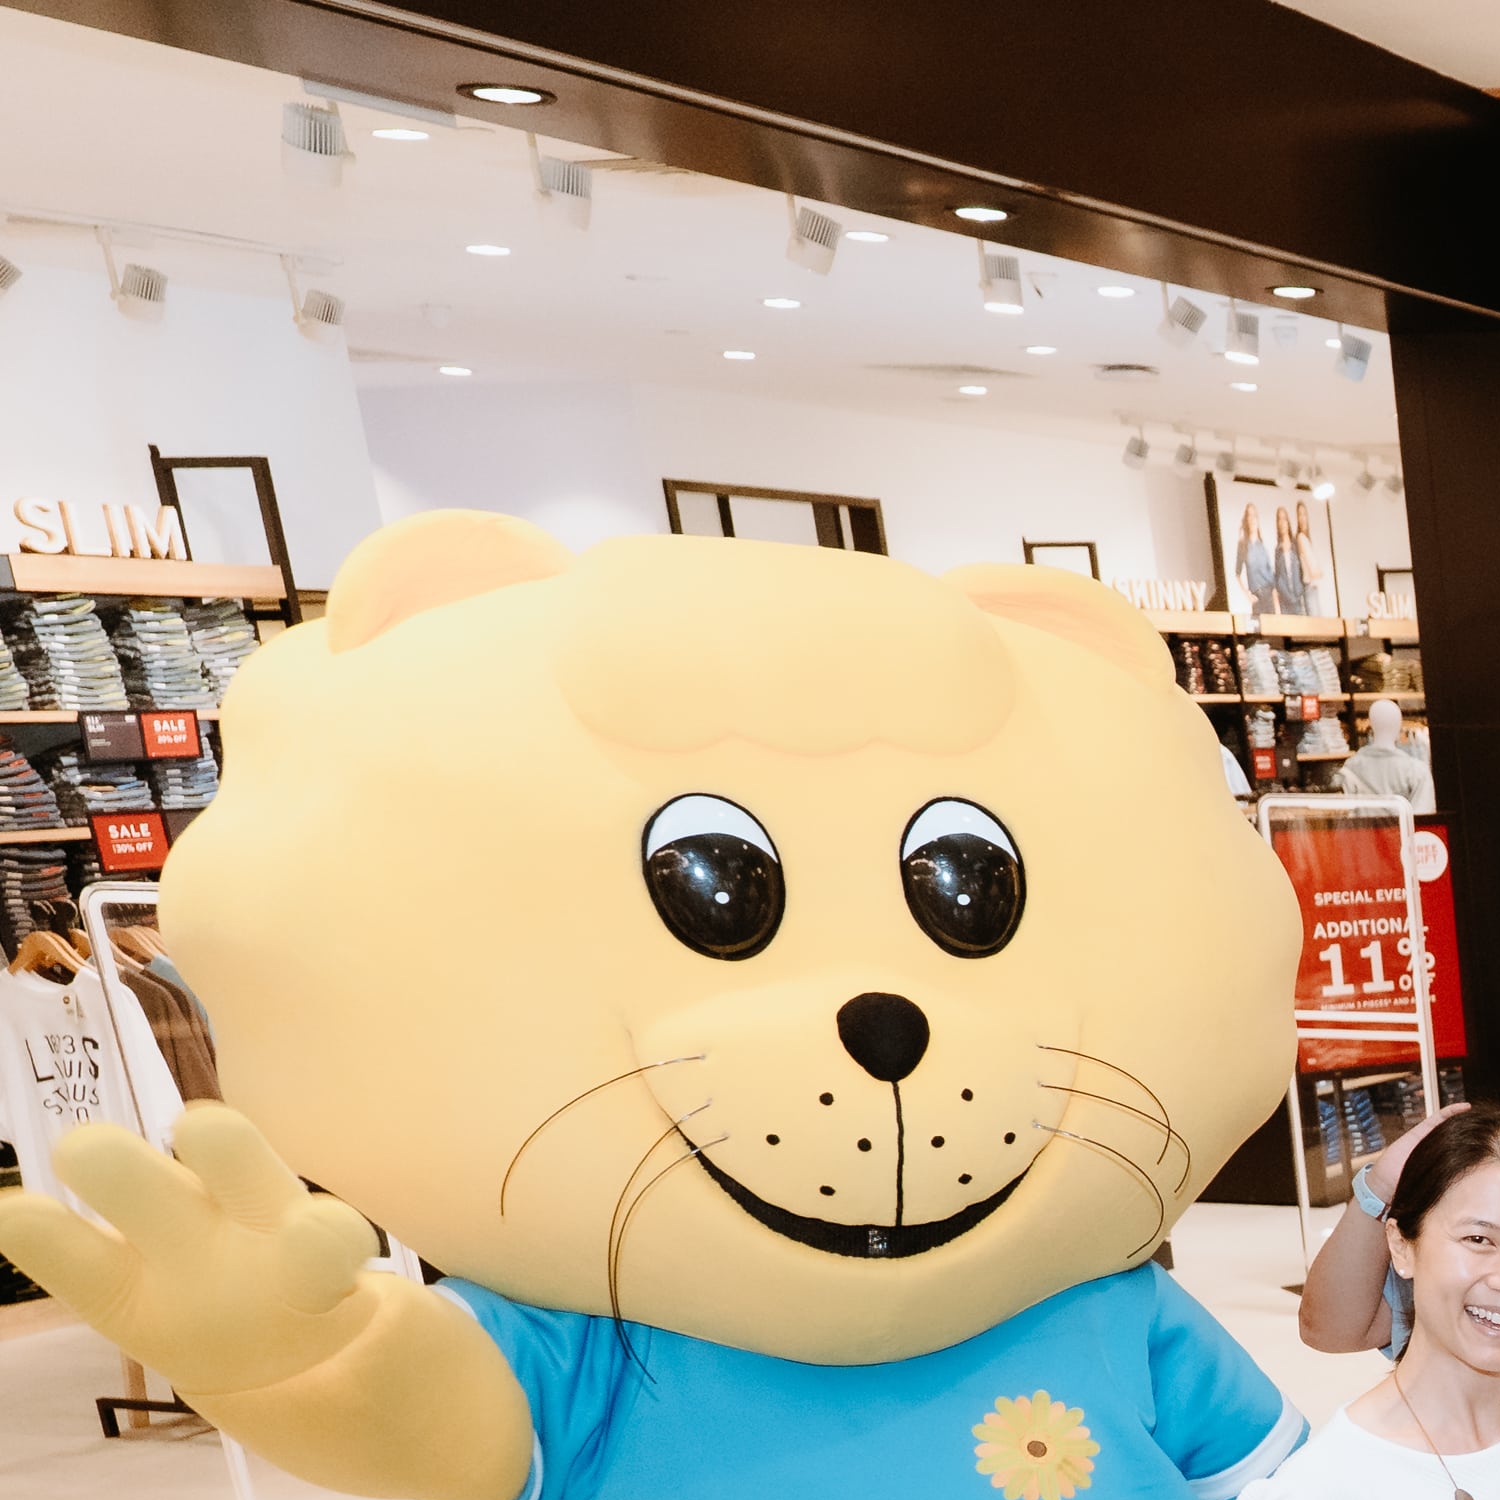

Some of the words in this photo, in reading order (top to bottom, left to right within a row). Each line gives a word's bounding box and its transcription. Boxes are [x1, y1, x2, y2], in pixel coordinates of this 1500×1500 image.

[15, 497, 190, 561] SLIM
[1112, 577, 1207, 611] SKINNY
[1367, 592, 1415, 620] SLIM
[153, 719, 186, 733] SALE
[108, 823, 151, 839] SALE
[1314, 890, 1372, 906] SPECIAL
